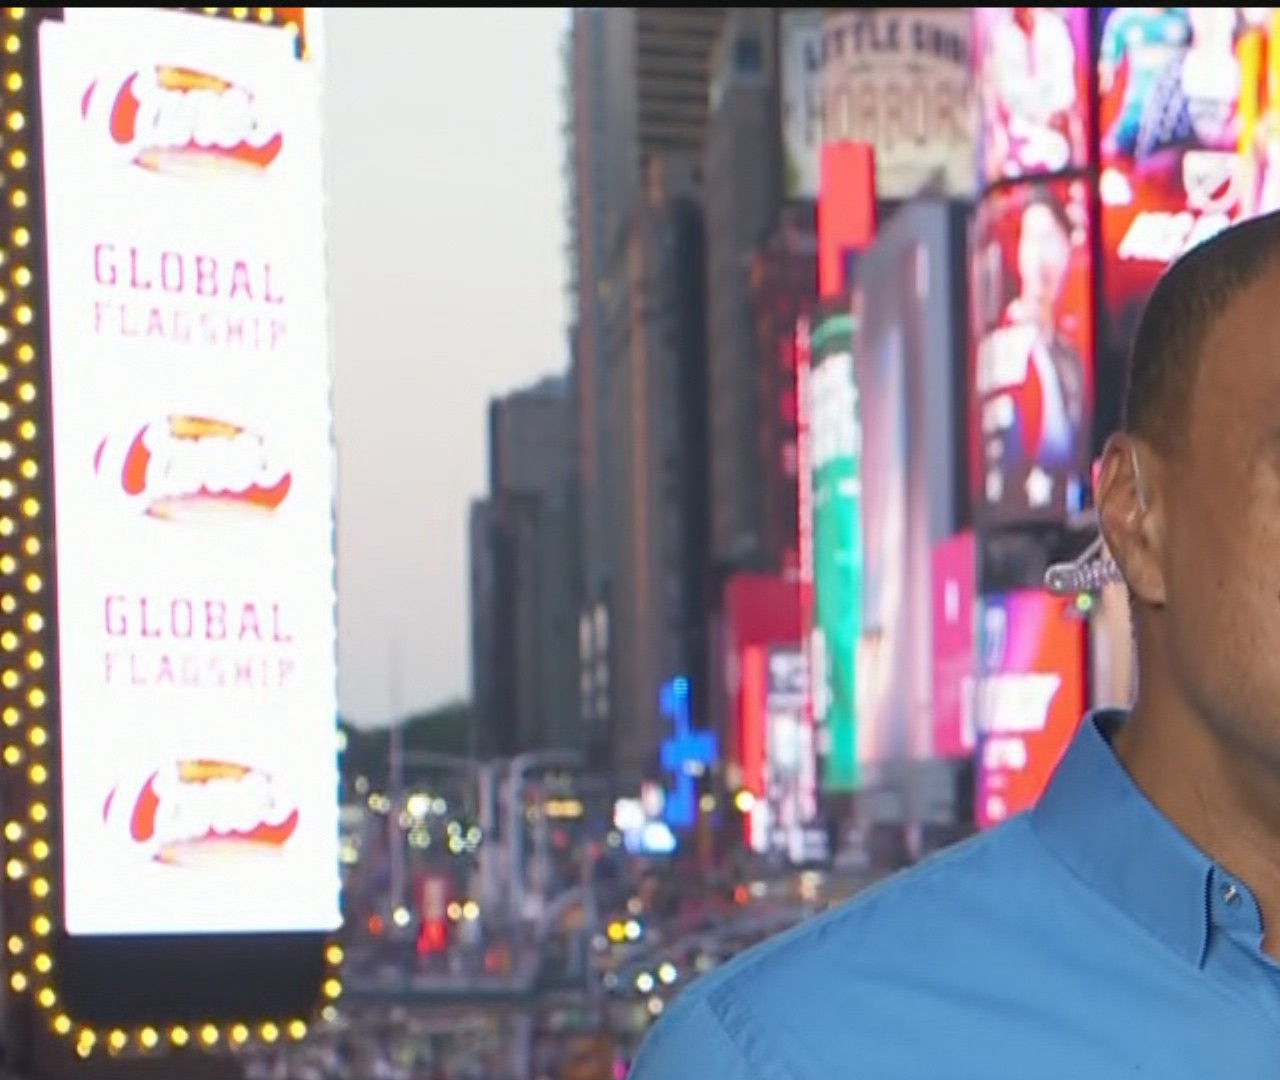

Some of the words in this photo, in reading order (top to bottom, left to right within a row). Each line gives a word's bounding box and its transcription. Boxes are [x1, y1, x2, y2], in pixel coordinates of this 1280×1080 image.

[94, 243, 284, 304] GLOBAL
[94, 301, 288, 350] FLAGSHIP
[104, 595, 293, 643] GLOBAL
[104, 652, 295, 689] FLAGSHIP
